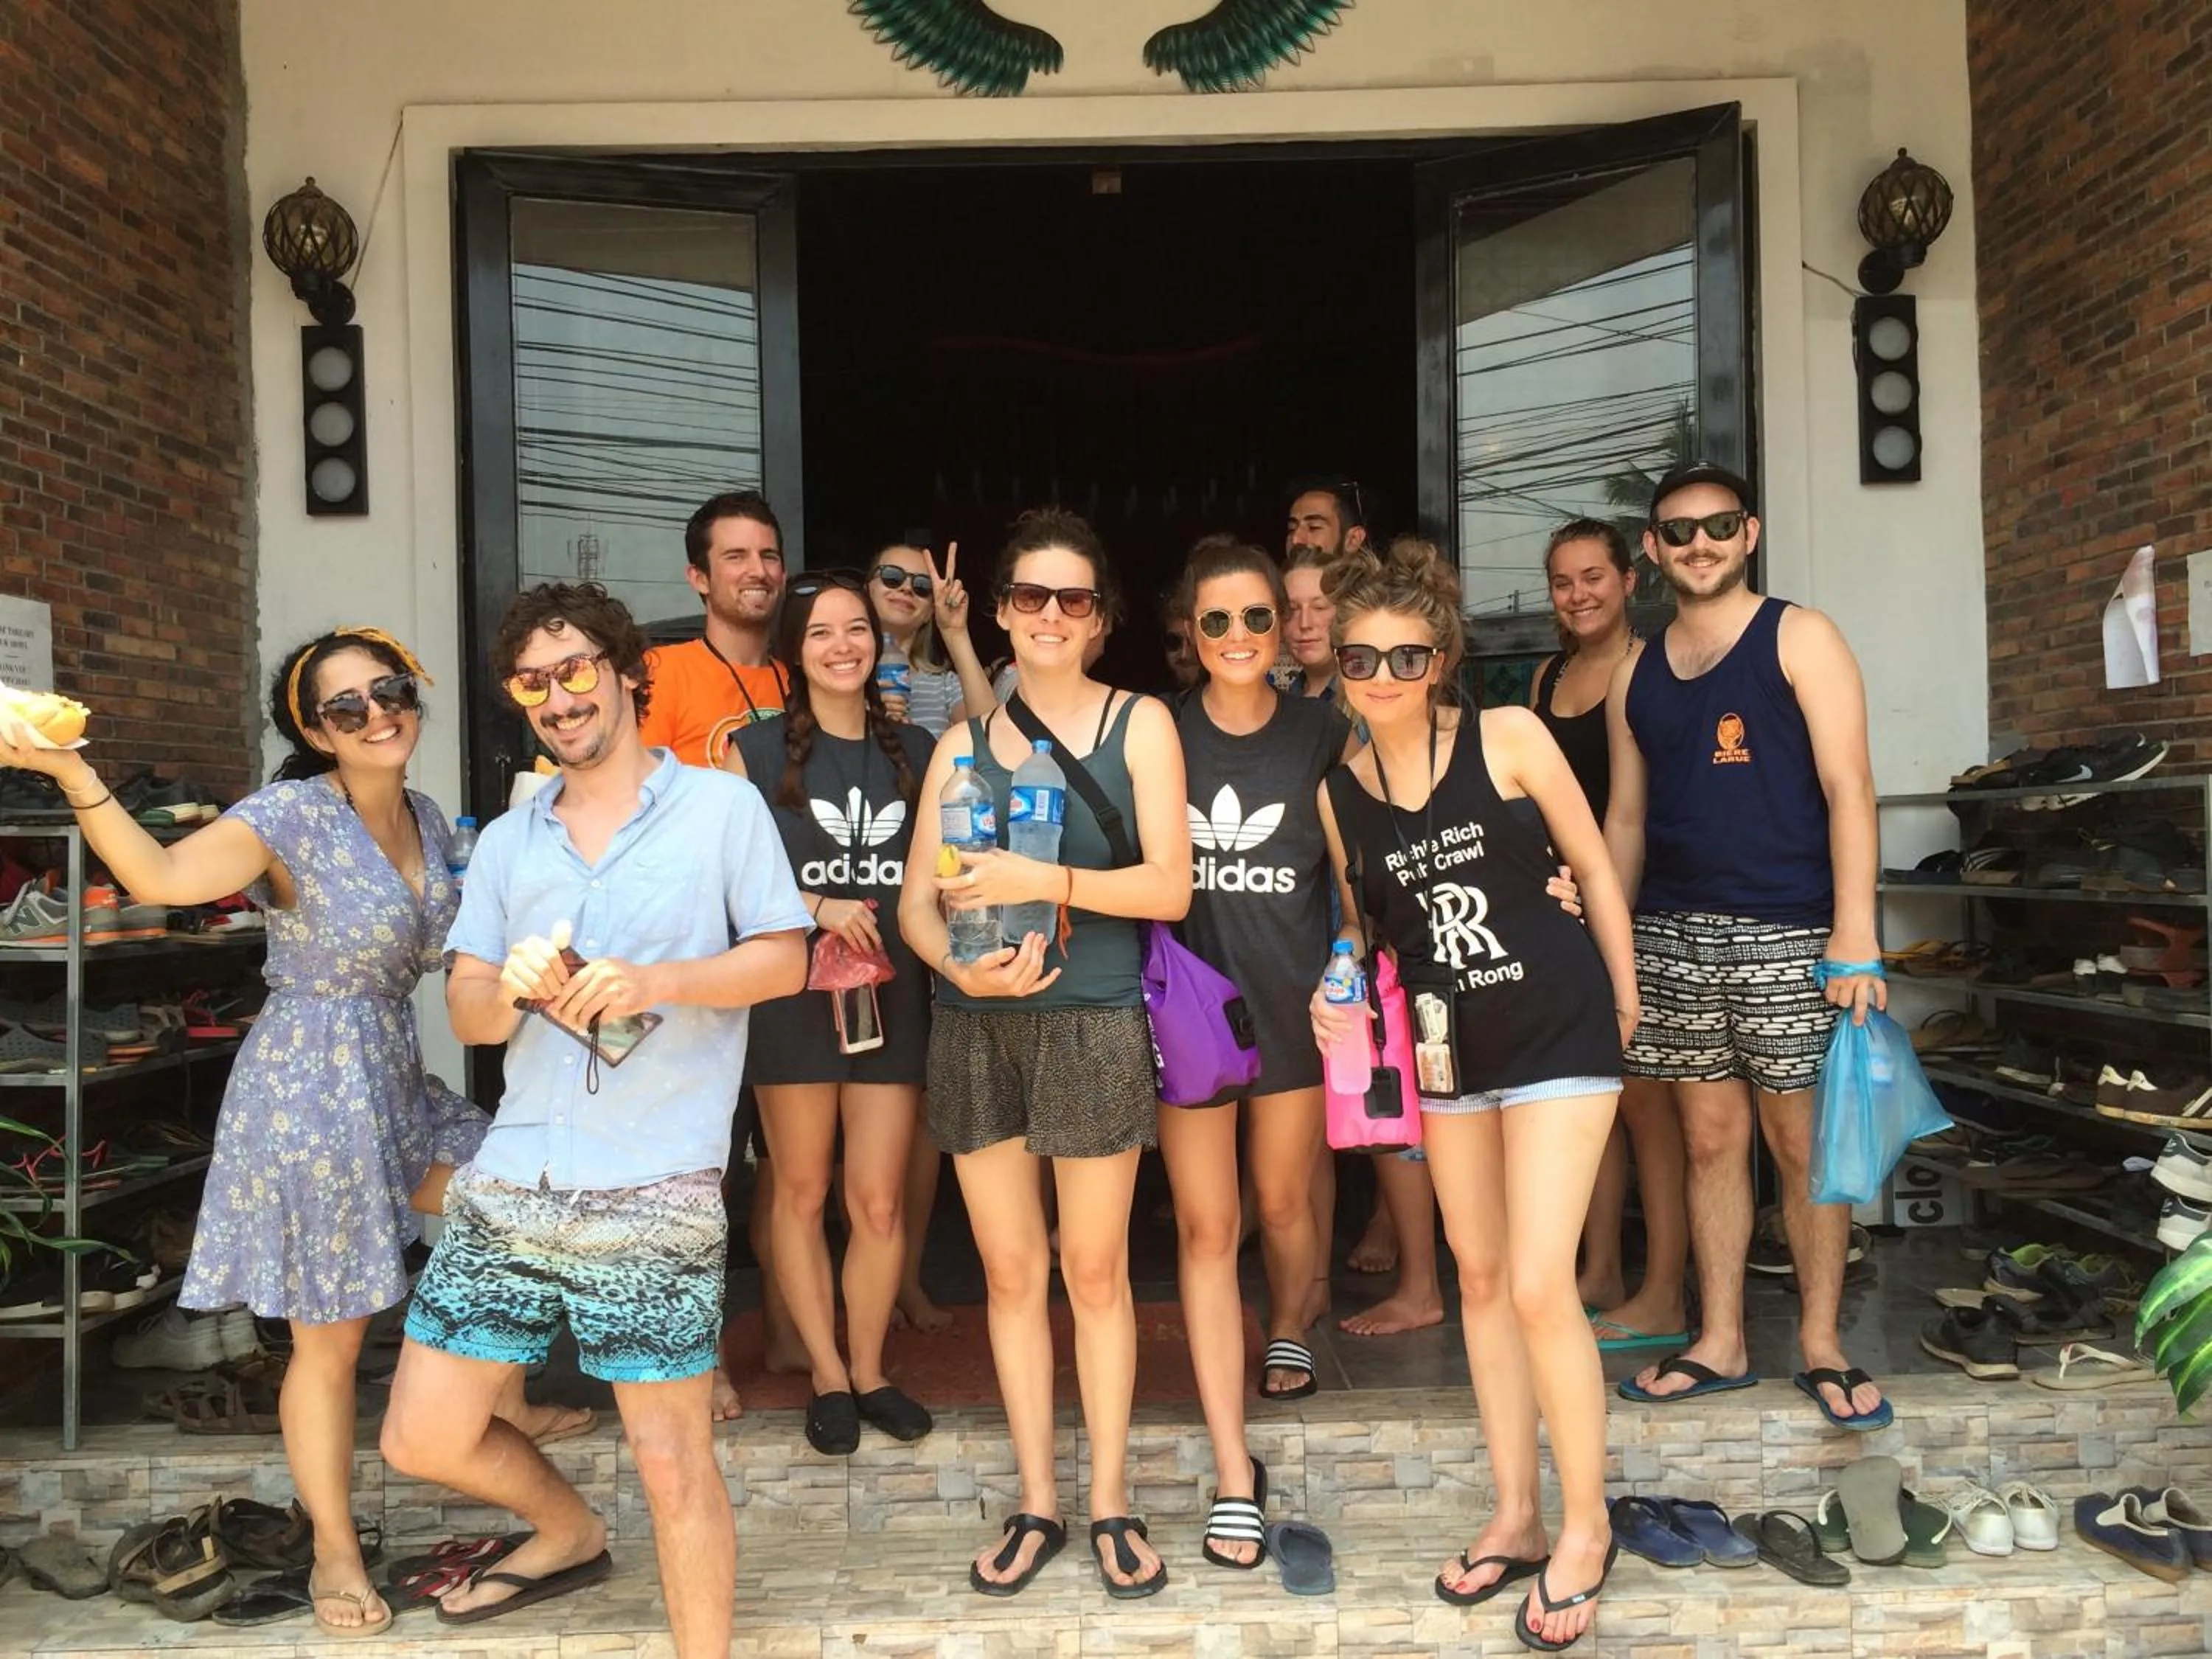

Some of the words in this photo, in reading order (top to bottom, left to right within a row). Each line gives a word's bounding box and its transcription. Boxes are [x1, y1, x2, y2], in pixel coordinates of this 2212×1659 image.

[1440, 821, 1484, 847] Rich
[1434, 841, 1484, 870] Crawl
[1192, 857, 1296, 893] didas
[1467, 961, 1524, 989] Rong
